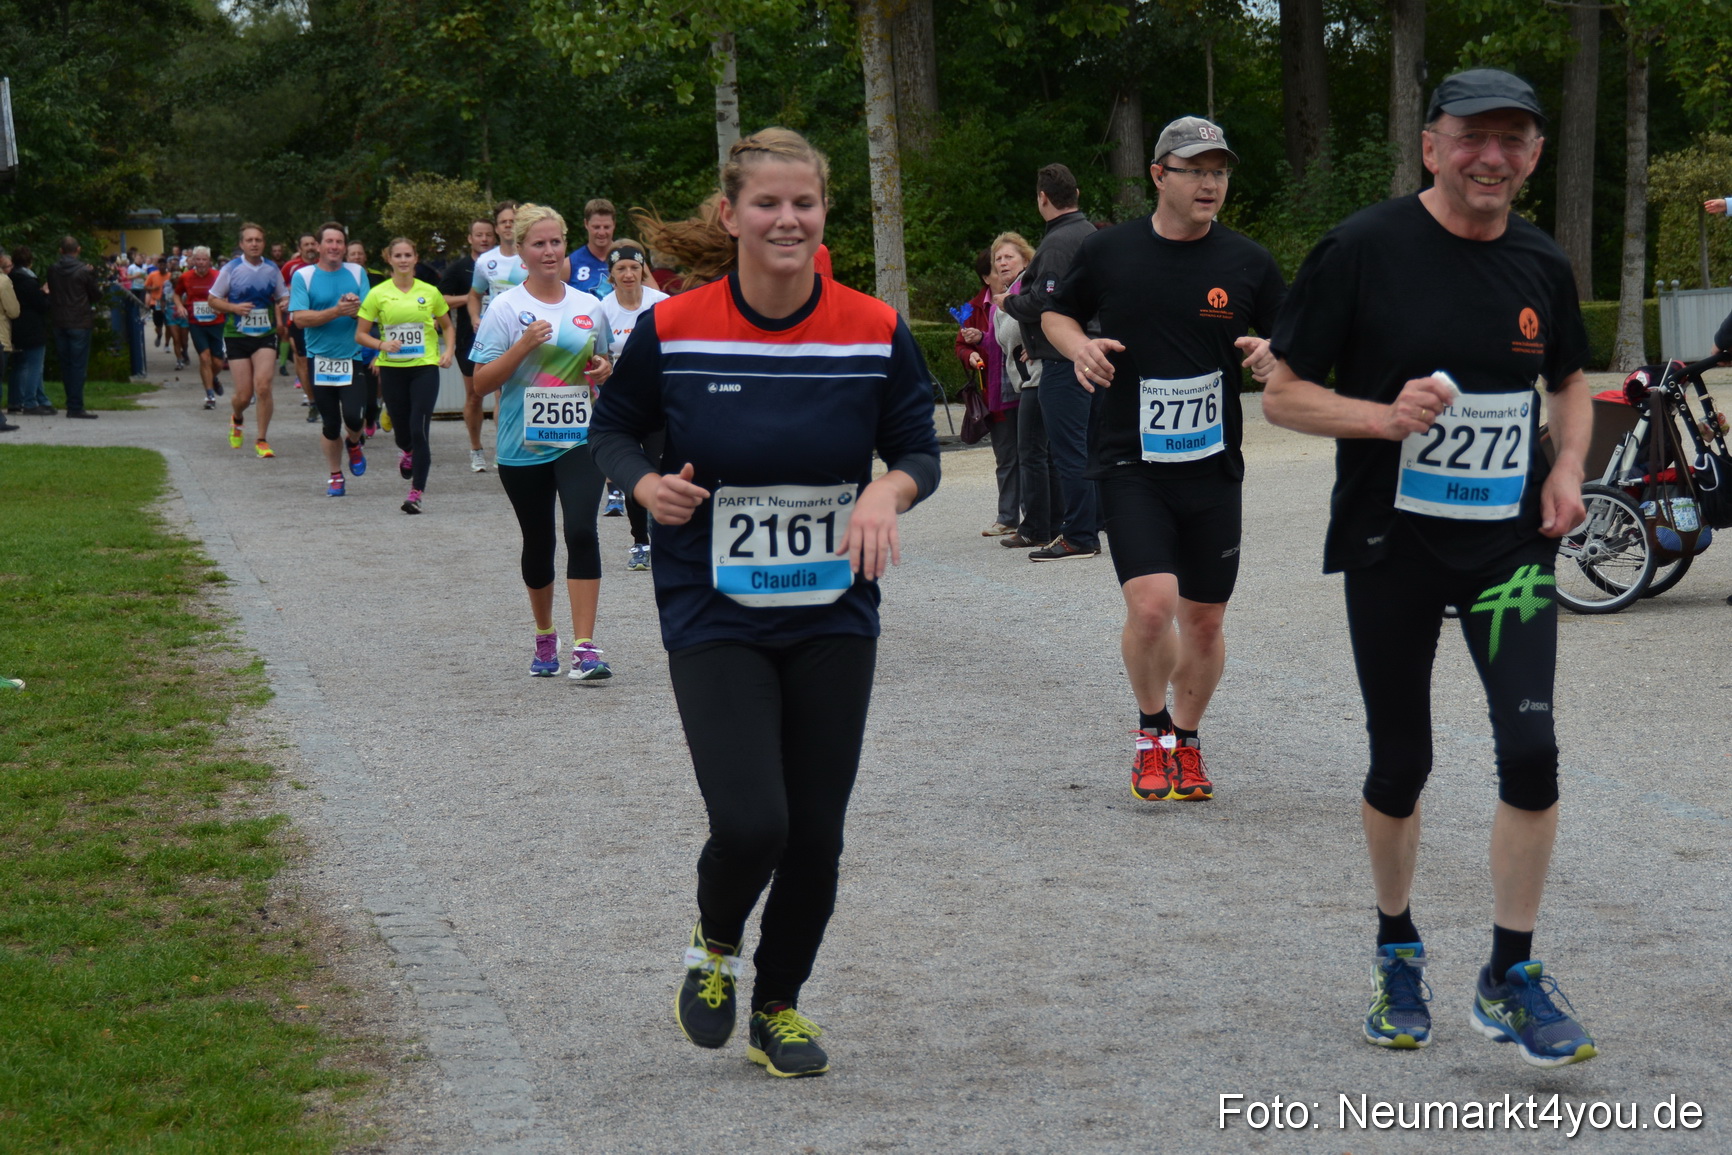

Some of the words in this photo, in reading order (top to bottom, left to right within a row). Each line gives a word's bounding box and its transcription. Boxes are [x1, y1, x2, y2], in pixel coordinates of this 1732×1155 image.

[1199, 127, 1218, 141] 85
[577, 266, 591, 281] 8
[245, 315, 268, 326] 2114
[390, 331, 422, 345] 2499
[319, 361, 349, 374] 2420
[719, 384, 742, 392] JAKO
[1142, 386, 1170, 396] PARTL
[1172, 383, 1212, 396] Neumarkt
[526, 392, 550, 400] PARTL
[532, 402, 587, 425] 2565
[1149, 393, 1217, 430] 2776
[1461, 407, 1518, 419] Neumarkt
[538, 430, 582, 440] Katharina
[1165, 434, 1206, 450] Roland
[1416, 423, 1522, 470] 2272
[1446, 482, 1490, 501] Hans
[718, 497, 765, 507] PARTL
[768, 496, 833, 508] Neumarkt
[729, 511, 836, 558] 2161
[751, 569, 817, 589] Claudia
